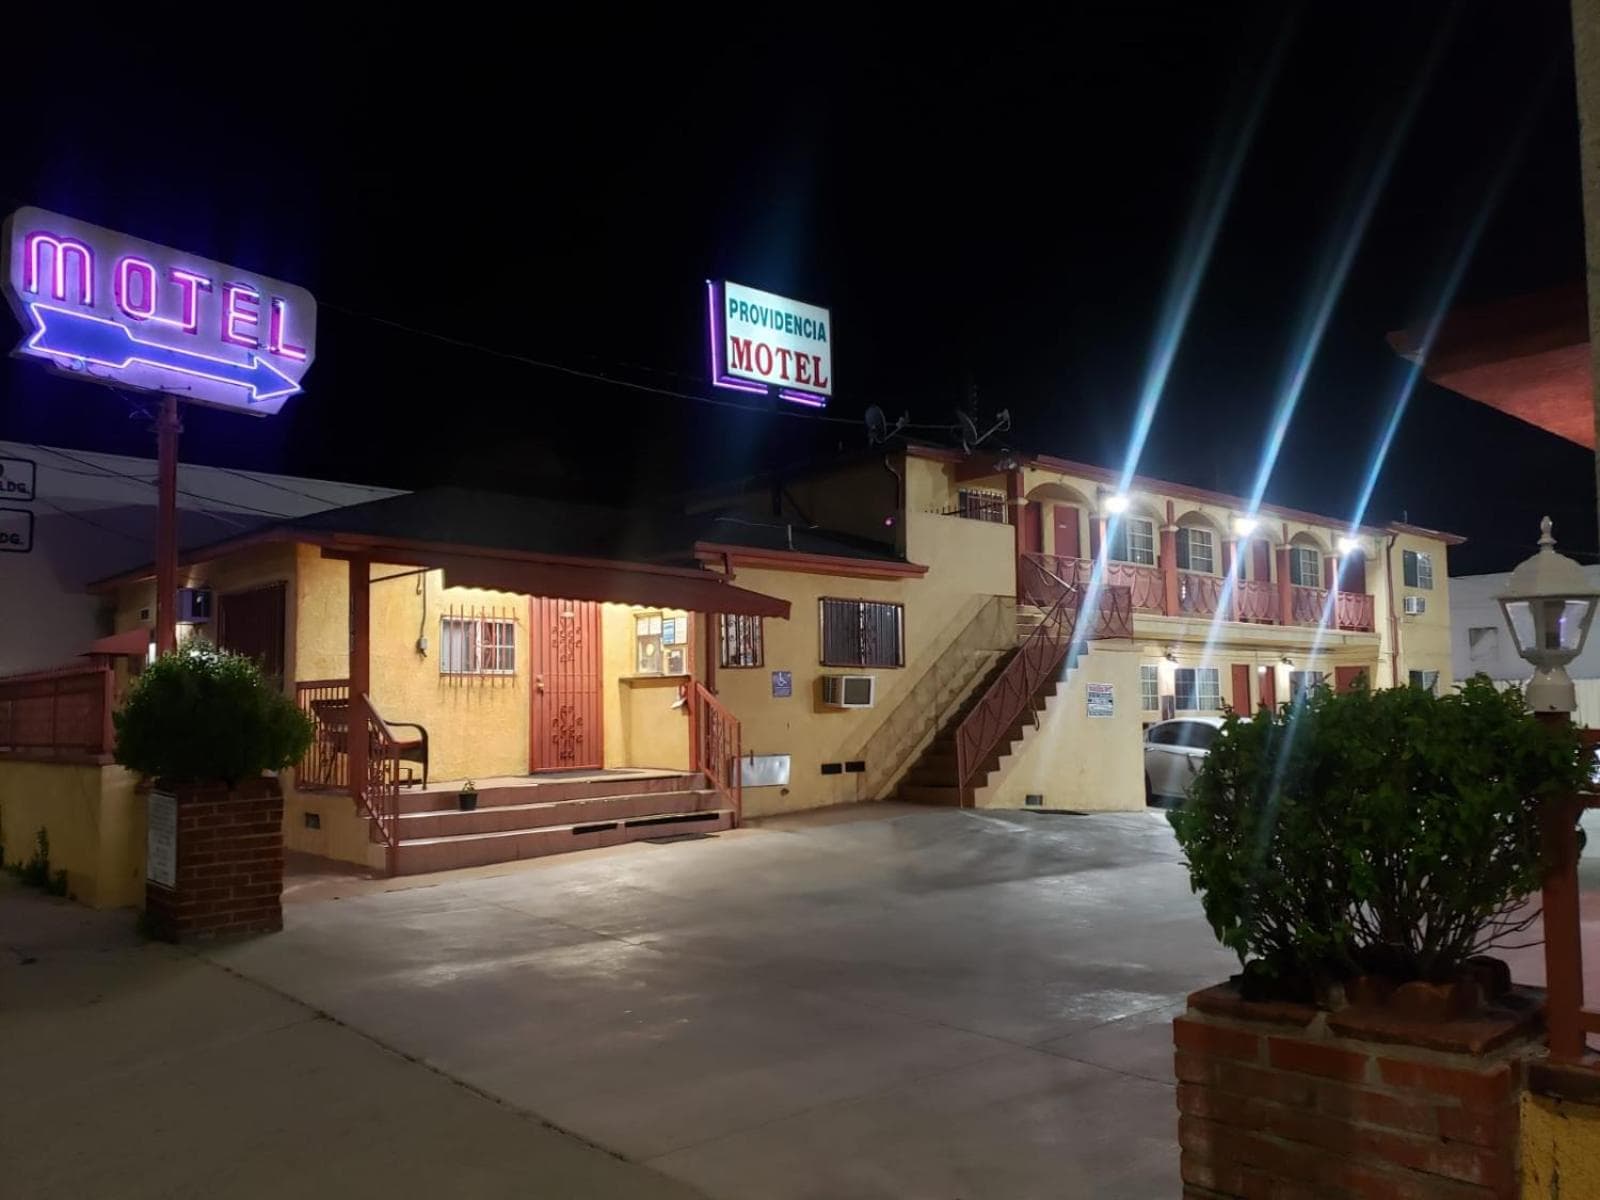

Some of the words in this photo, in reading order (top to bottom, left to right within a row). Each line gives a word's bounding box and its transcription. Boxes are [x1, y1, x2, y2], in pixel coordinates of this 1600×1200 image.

[23, 230, 307, 362] MOTEL
[728, 297, 827, 342] PROVIDENCIA
[729, 335, 828, 388] MOTEL
